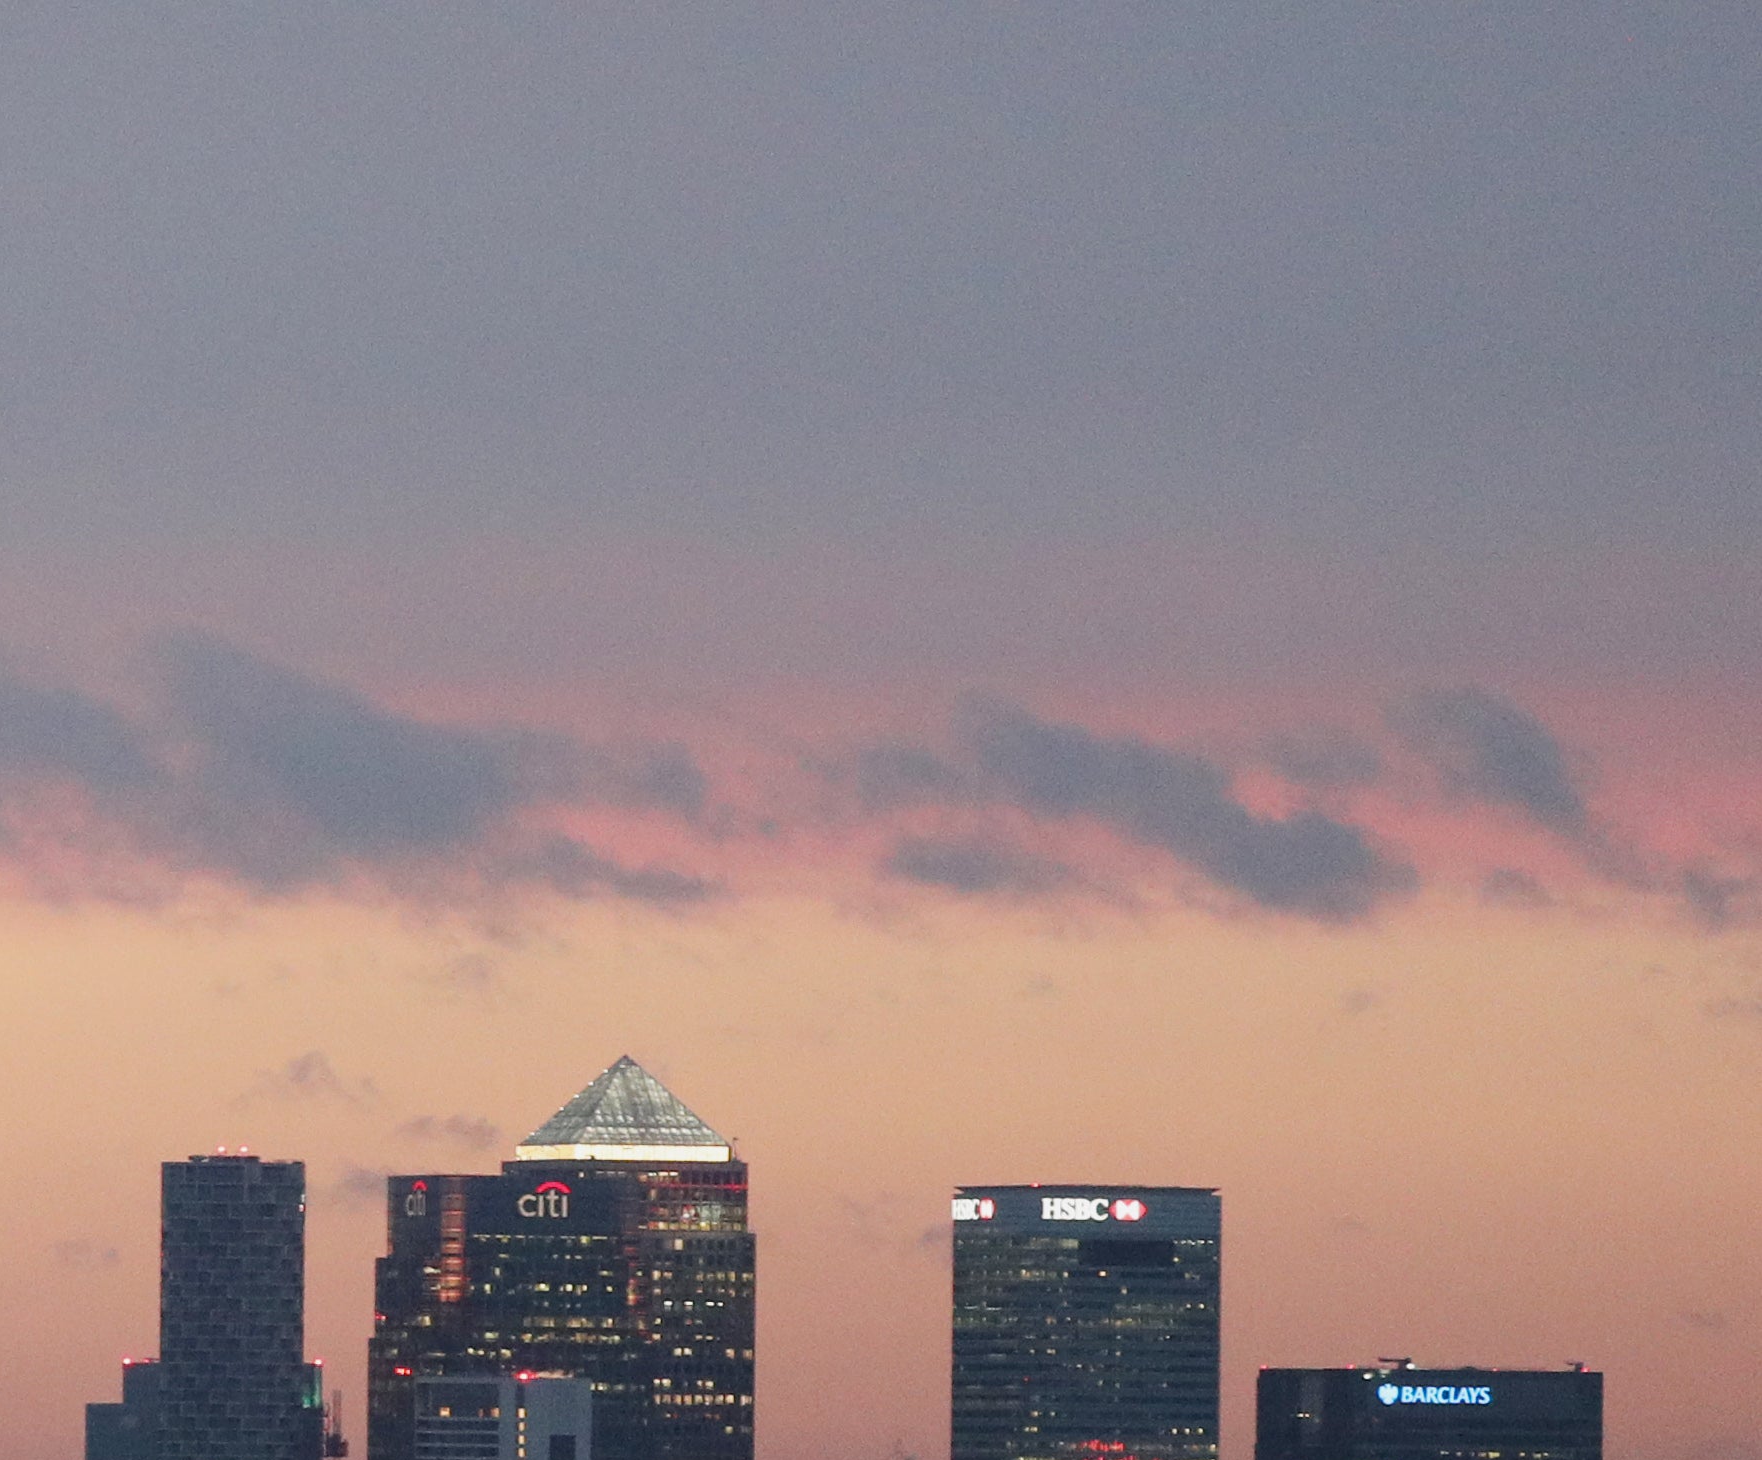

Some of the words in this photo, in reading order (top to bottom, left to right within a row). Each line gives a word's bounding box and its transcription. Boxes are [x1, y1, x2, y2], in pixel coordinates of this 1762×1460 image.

[517, 1188, 569, 1218] citi
[1041, 1199, 1108, 1220] HSBC
[1401, 1386, 1490, 1405] BARCLAYS
